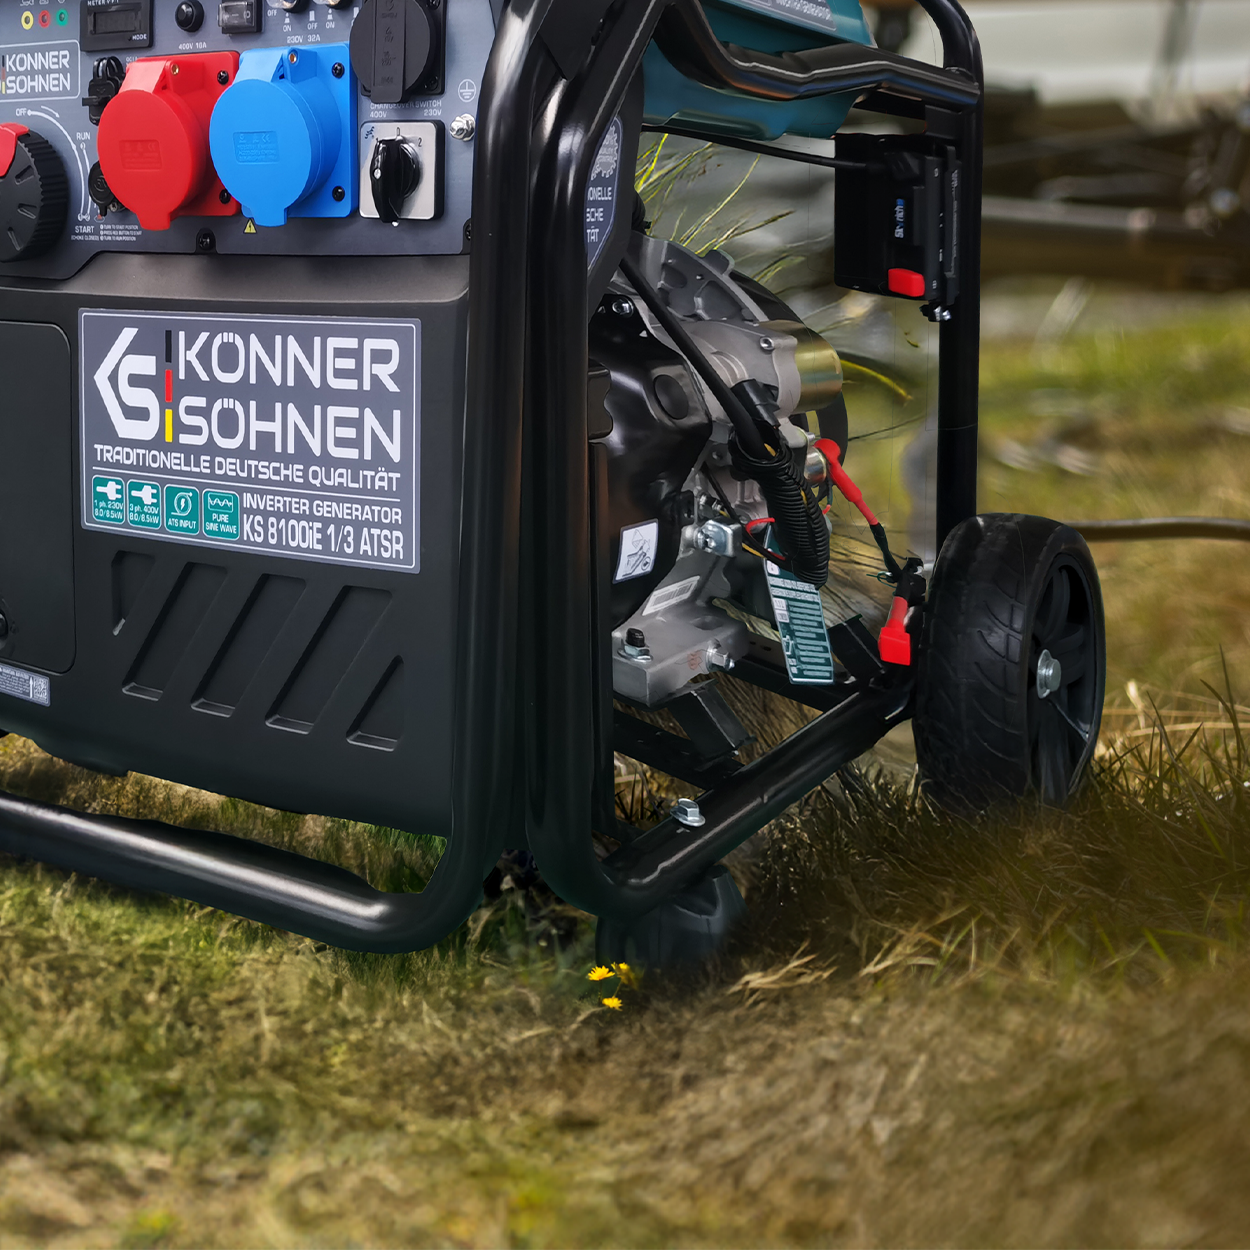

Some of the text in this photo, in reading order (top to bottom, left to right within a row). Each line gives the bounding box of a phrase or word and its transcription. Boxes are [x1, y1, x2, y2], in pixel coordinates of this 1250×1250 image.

[370, 100, 442, 110] CHANGEOVER SWITCH
[16, 108, 27, 116] OFF
[418, 138, 422, 147] 2
[94, 444, 400, 492] TRADITIONELLE DEUTSCHE QUALITÄT
[108, 501, 123, 510] 230V
[144, 506, 159, 514] 400V
[242, 492, 402, 525] INVERTER GENERATOR
[212, 513, 229, 522] PURE
[168, 518, 196, 529] ATS INPUT
[206, 522, 237, 534] SINE WAVE
[244, 513, 404, 560] KS 8100iE 1/3 ATSR
